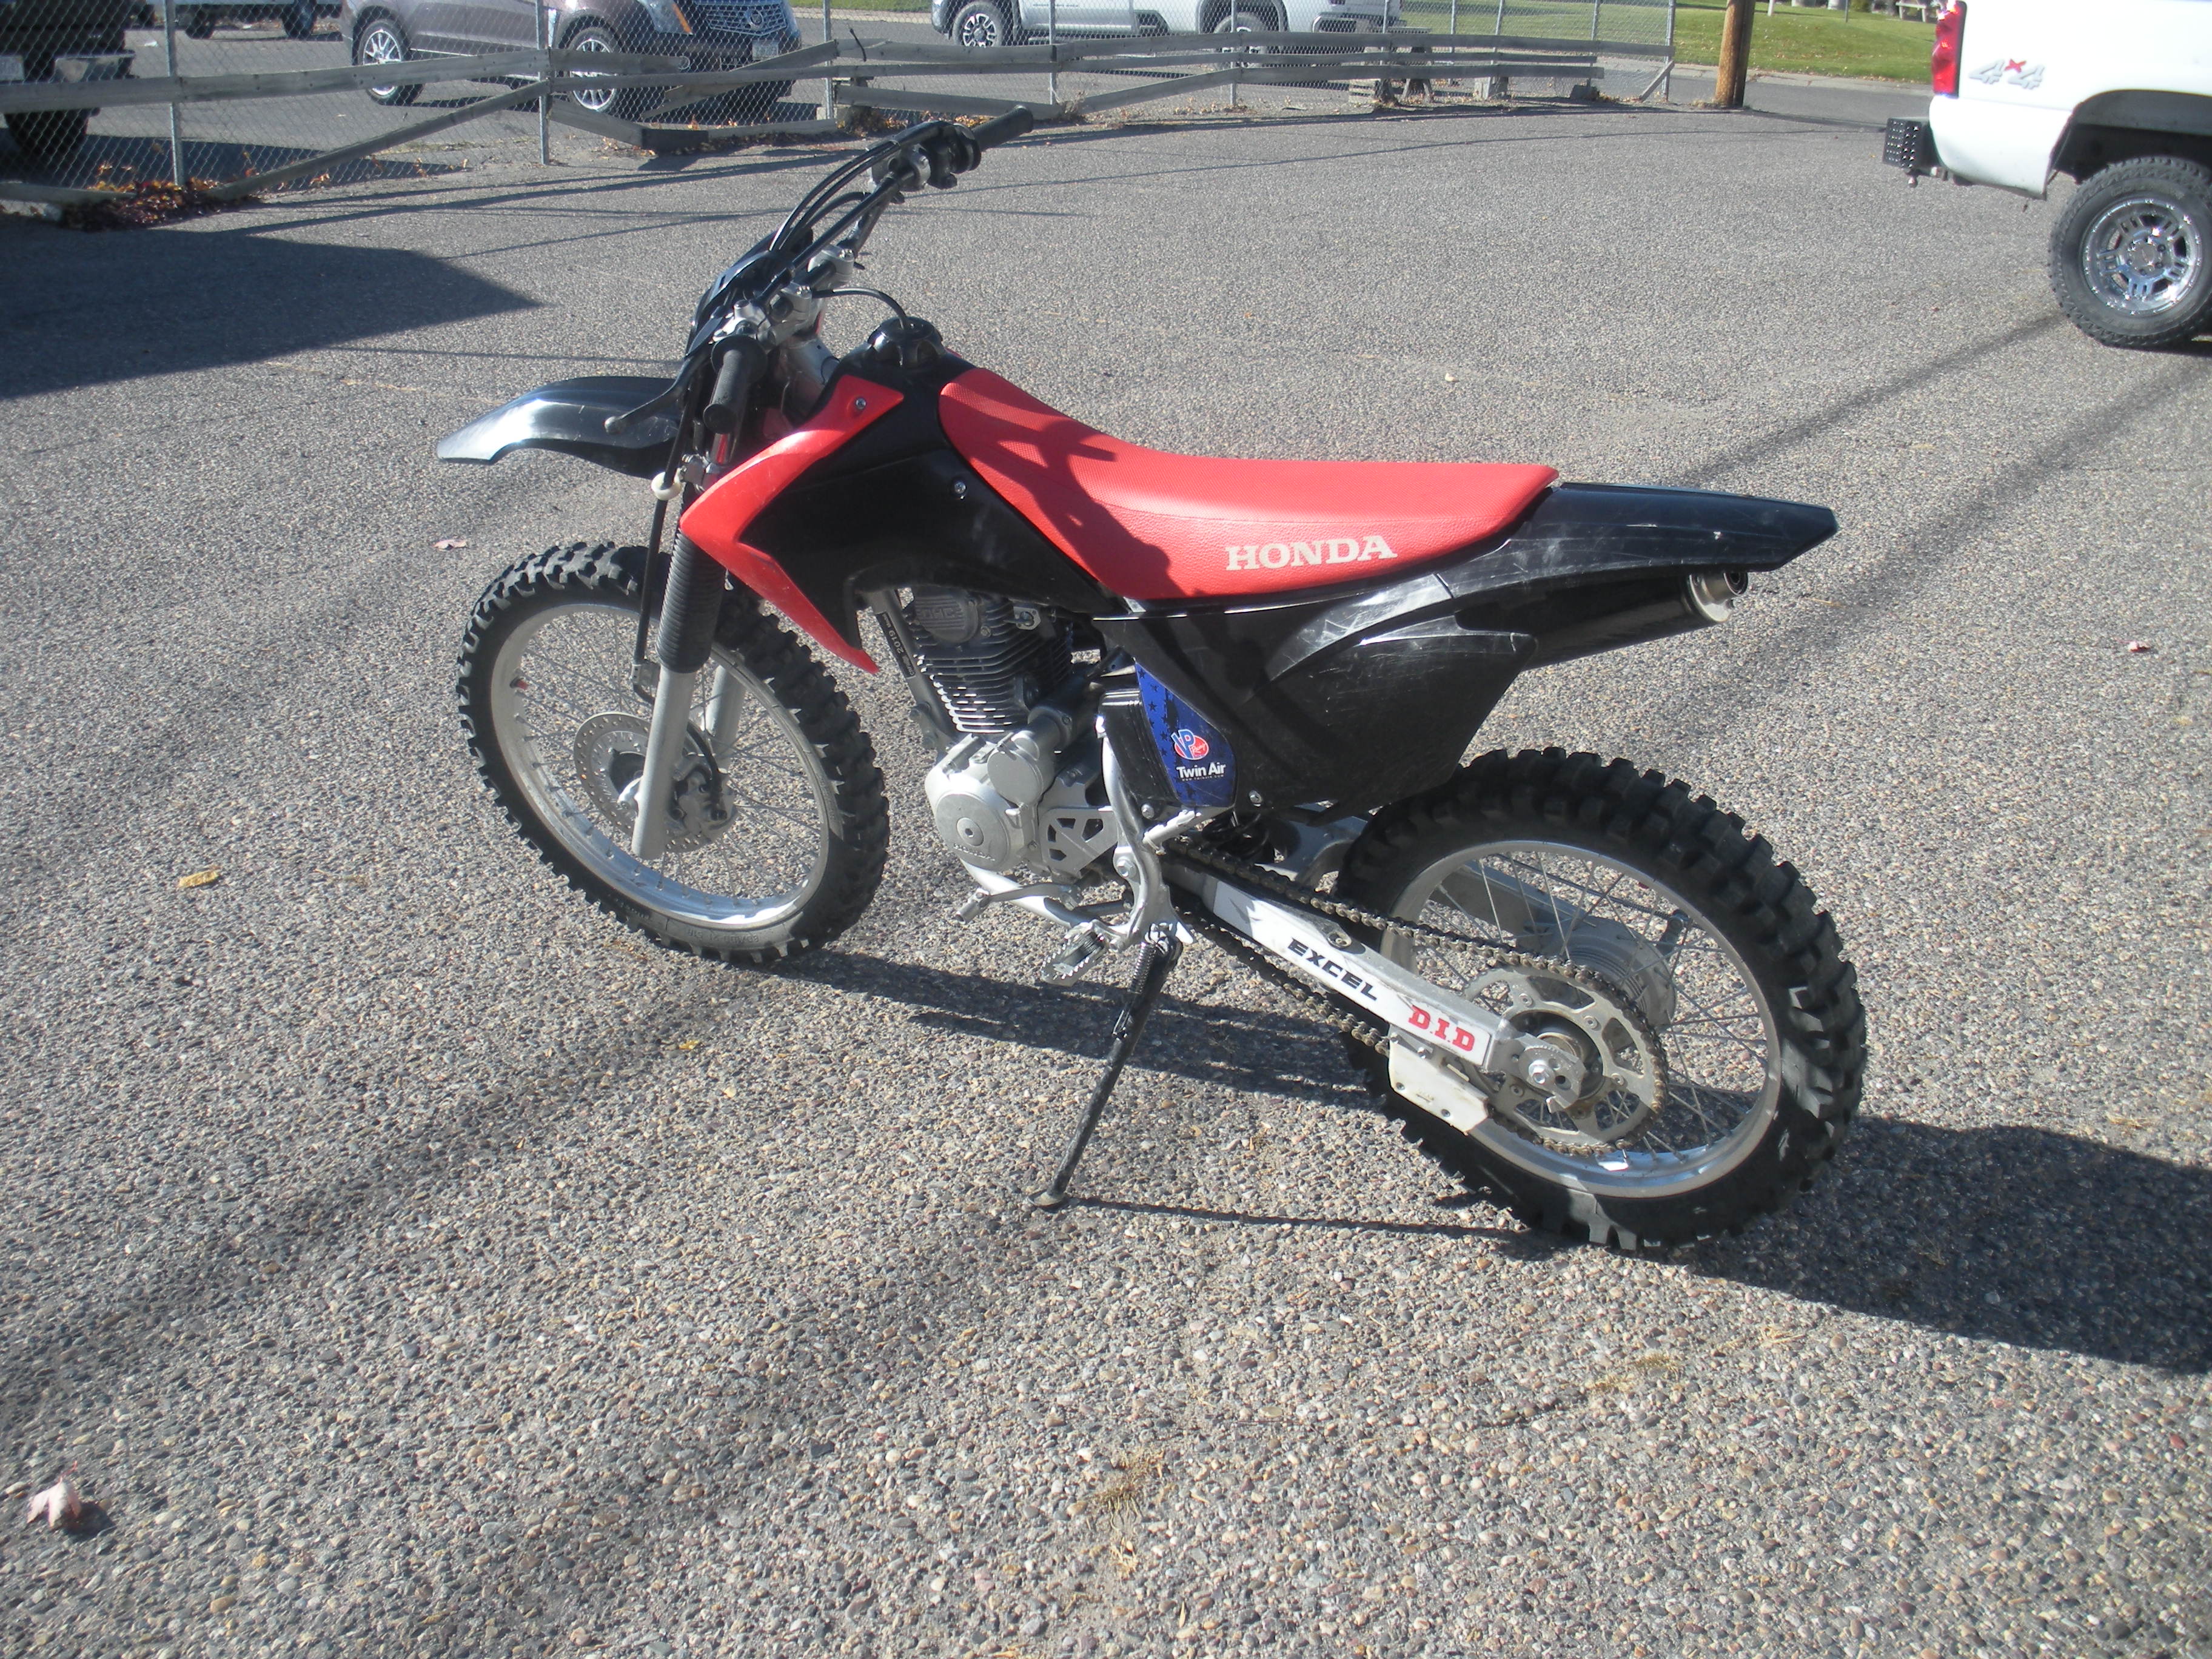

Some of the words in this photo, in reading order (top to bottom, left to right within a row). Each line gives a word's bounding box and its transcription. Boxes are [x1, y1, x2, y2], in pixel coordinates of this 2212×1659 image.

[1225, 535, 1398, 571] HONDA
[889, 630, 904, 654] 2019
[1176, 764, 1207, 779] Twin
[1208, 762, 1226, 775] Air
[1287, 937, 1381, 1001] EXCEL
